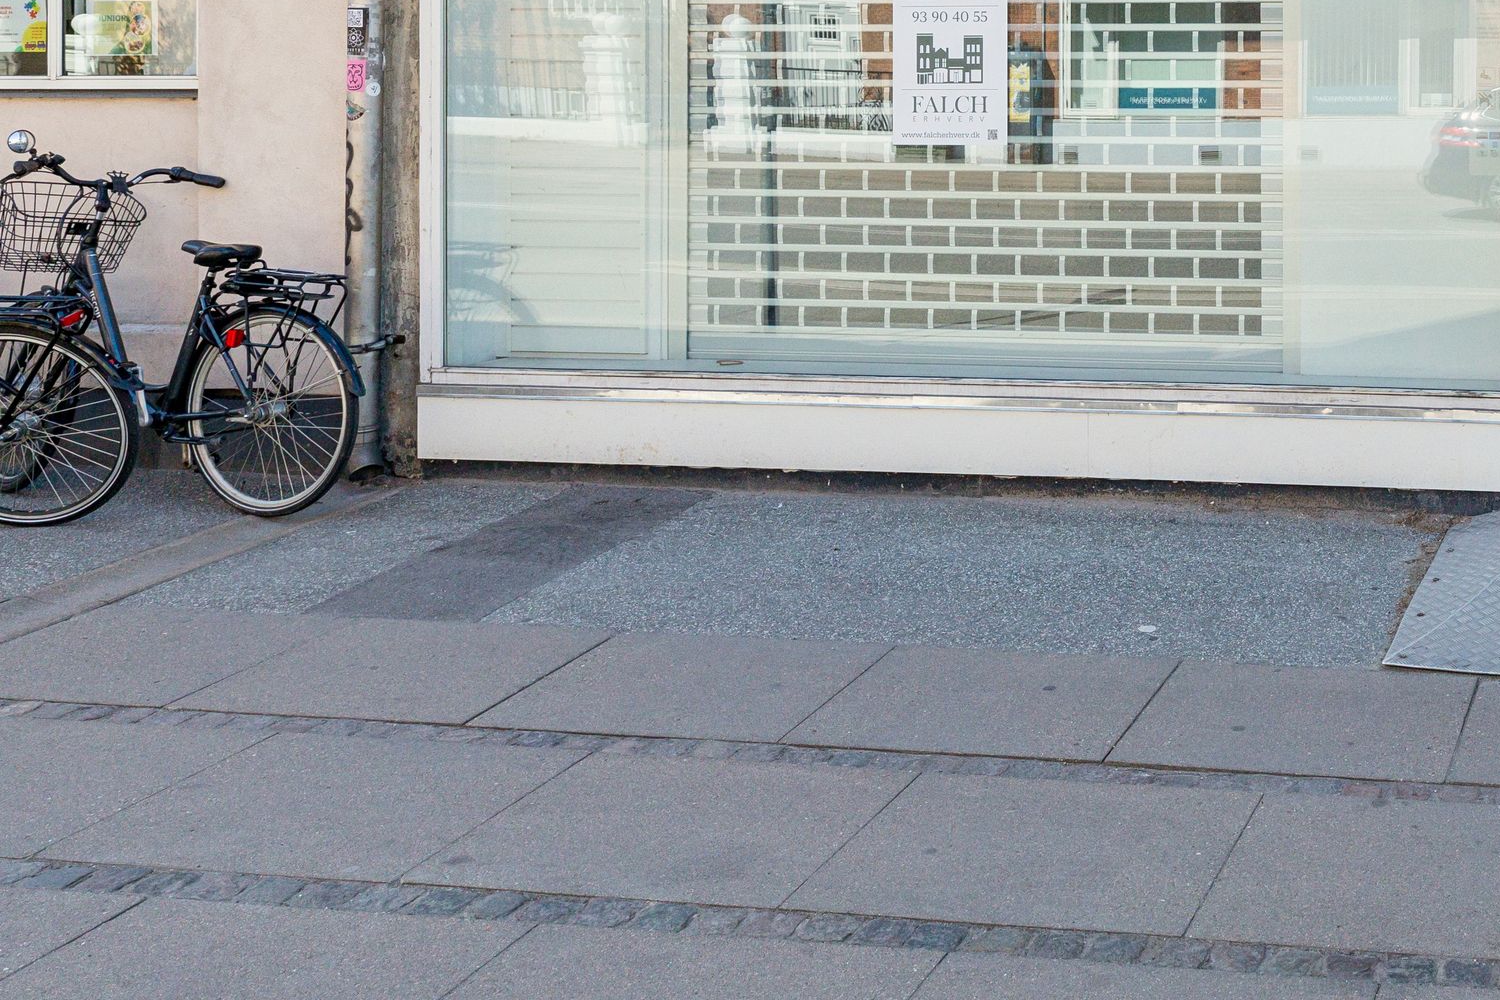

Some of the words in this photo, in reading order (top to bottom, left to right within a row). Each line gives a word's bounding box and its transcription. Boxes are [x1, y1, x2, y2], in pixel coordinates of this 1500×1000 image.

[912, 11, 928, 23] 93
[932, 11, 948, 23] 90
[952, 11, 970, 23] 40
[973, 11, 988, 23] 55
[912, 96, 988, 114] FALCH
[901, 130, 981, 139] www.falcherhverv.dk
